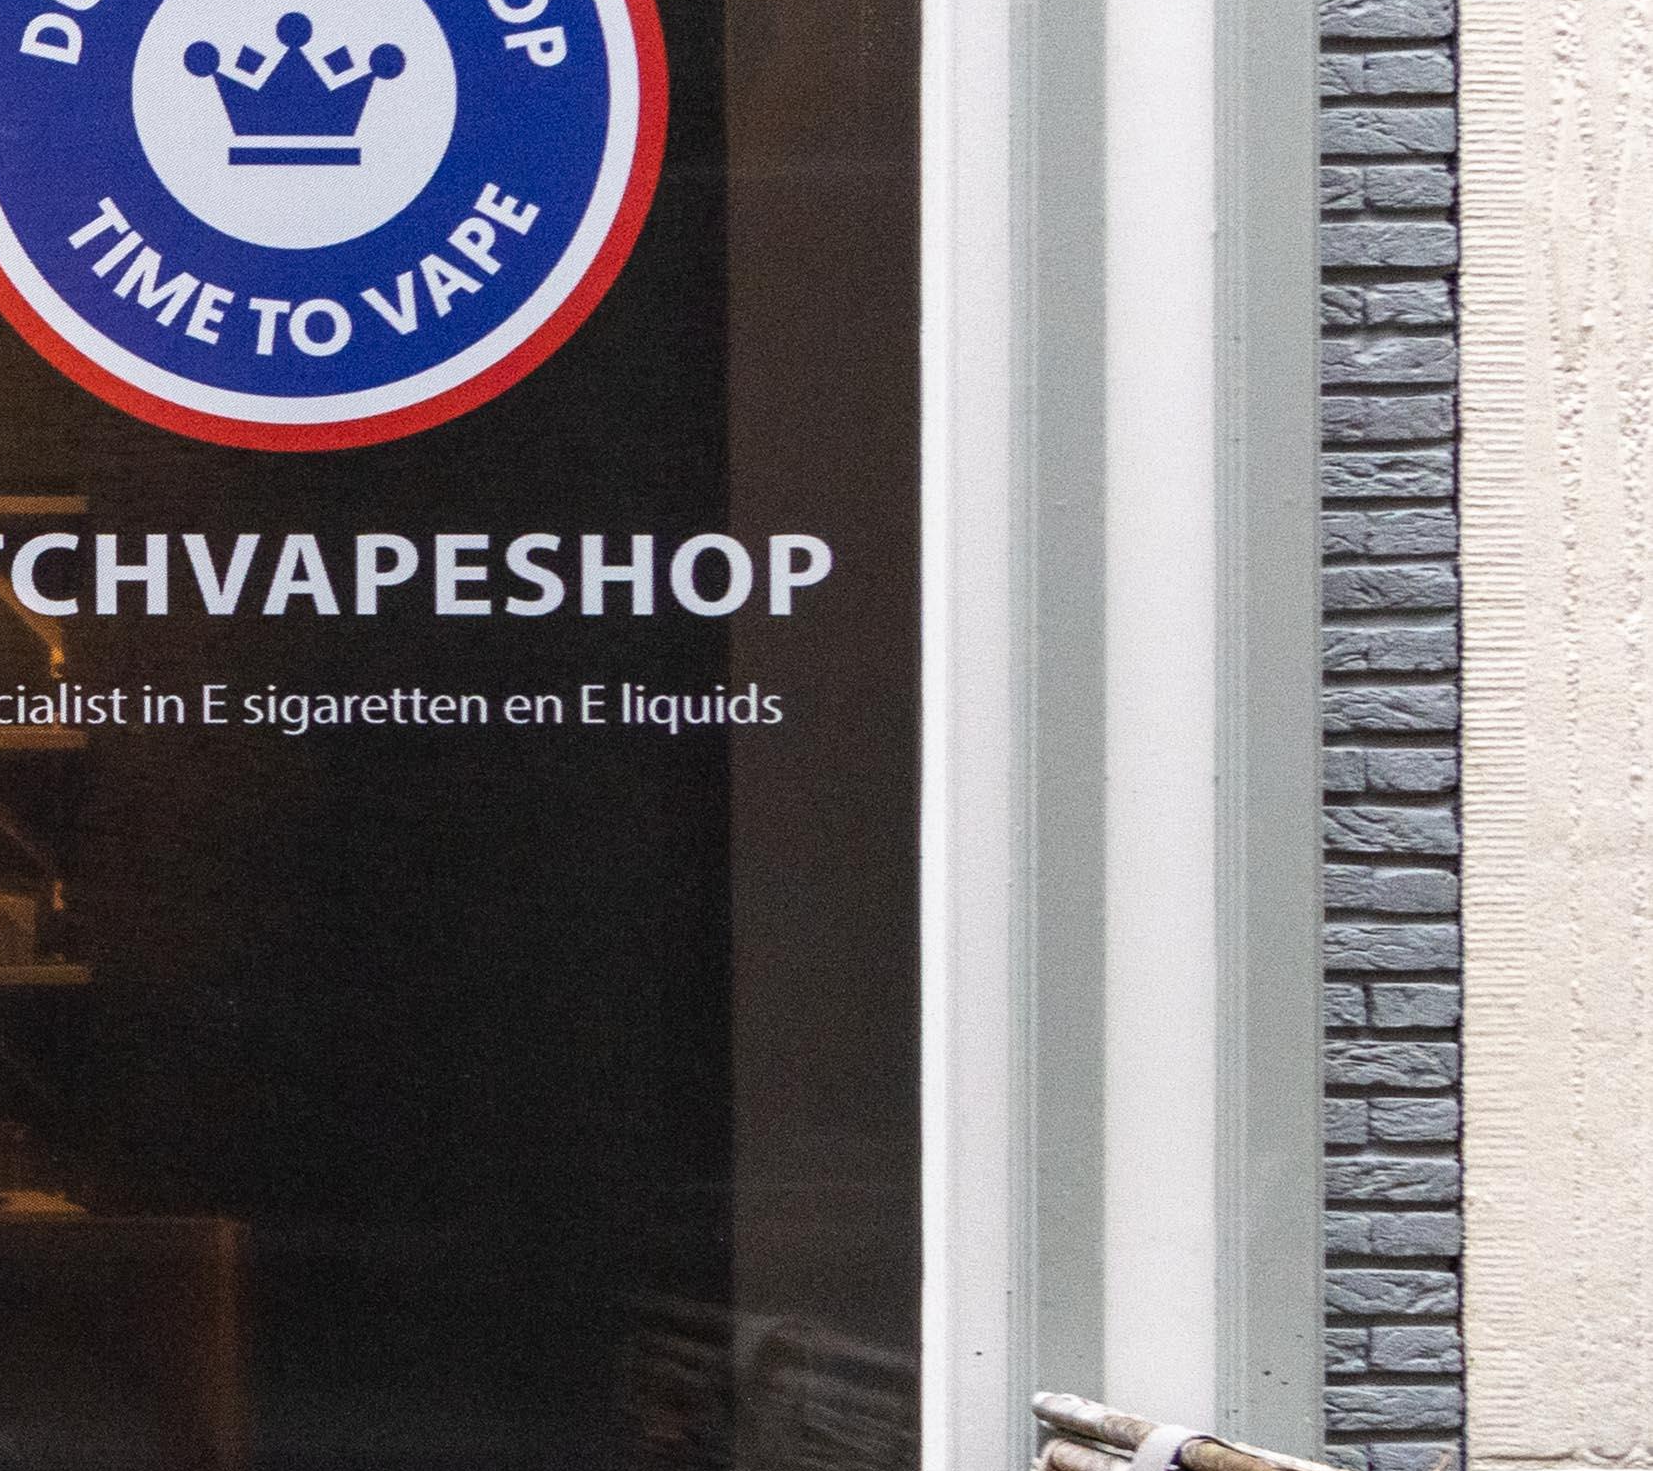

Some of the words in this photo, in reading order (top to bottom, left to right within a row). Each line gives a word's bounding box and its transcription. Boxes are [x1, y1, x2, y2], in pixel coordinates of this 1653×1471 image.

[68, 197, 236, 345] TIME
[249, 297, 353, 358] TO
[360, 181, 542, 338] VAPE
[144, 685, 184, 724] in
[202, 685, 228, 724] E
[243, 685, 488, 736] sigaretten
[504, 695, 562, 724] en
[581, 685, 606, 724] E
[623, 683, 784, 736] liquids
